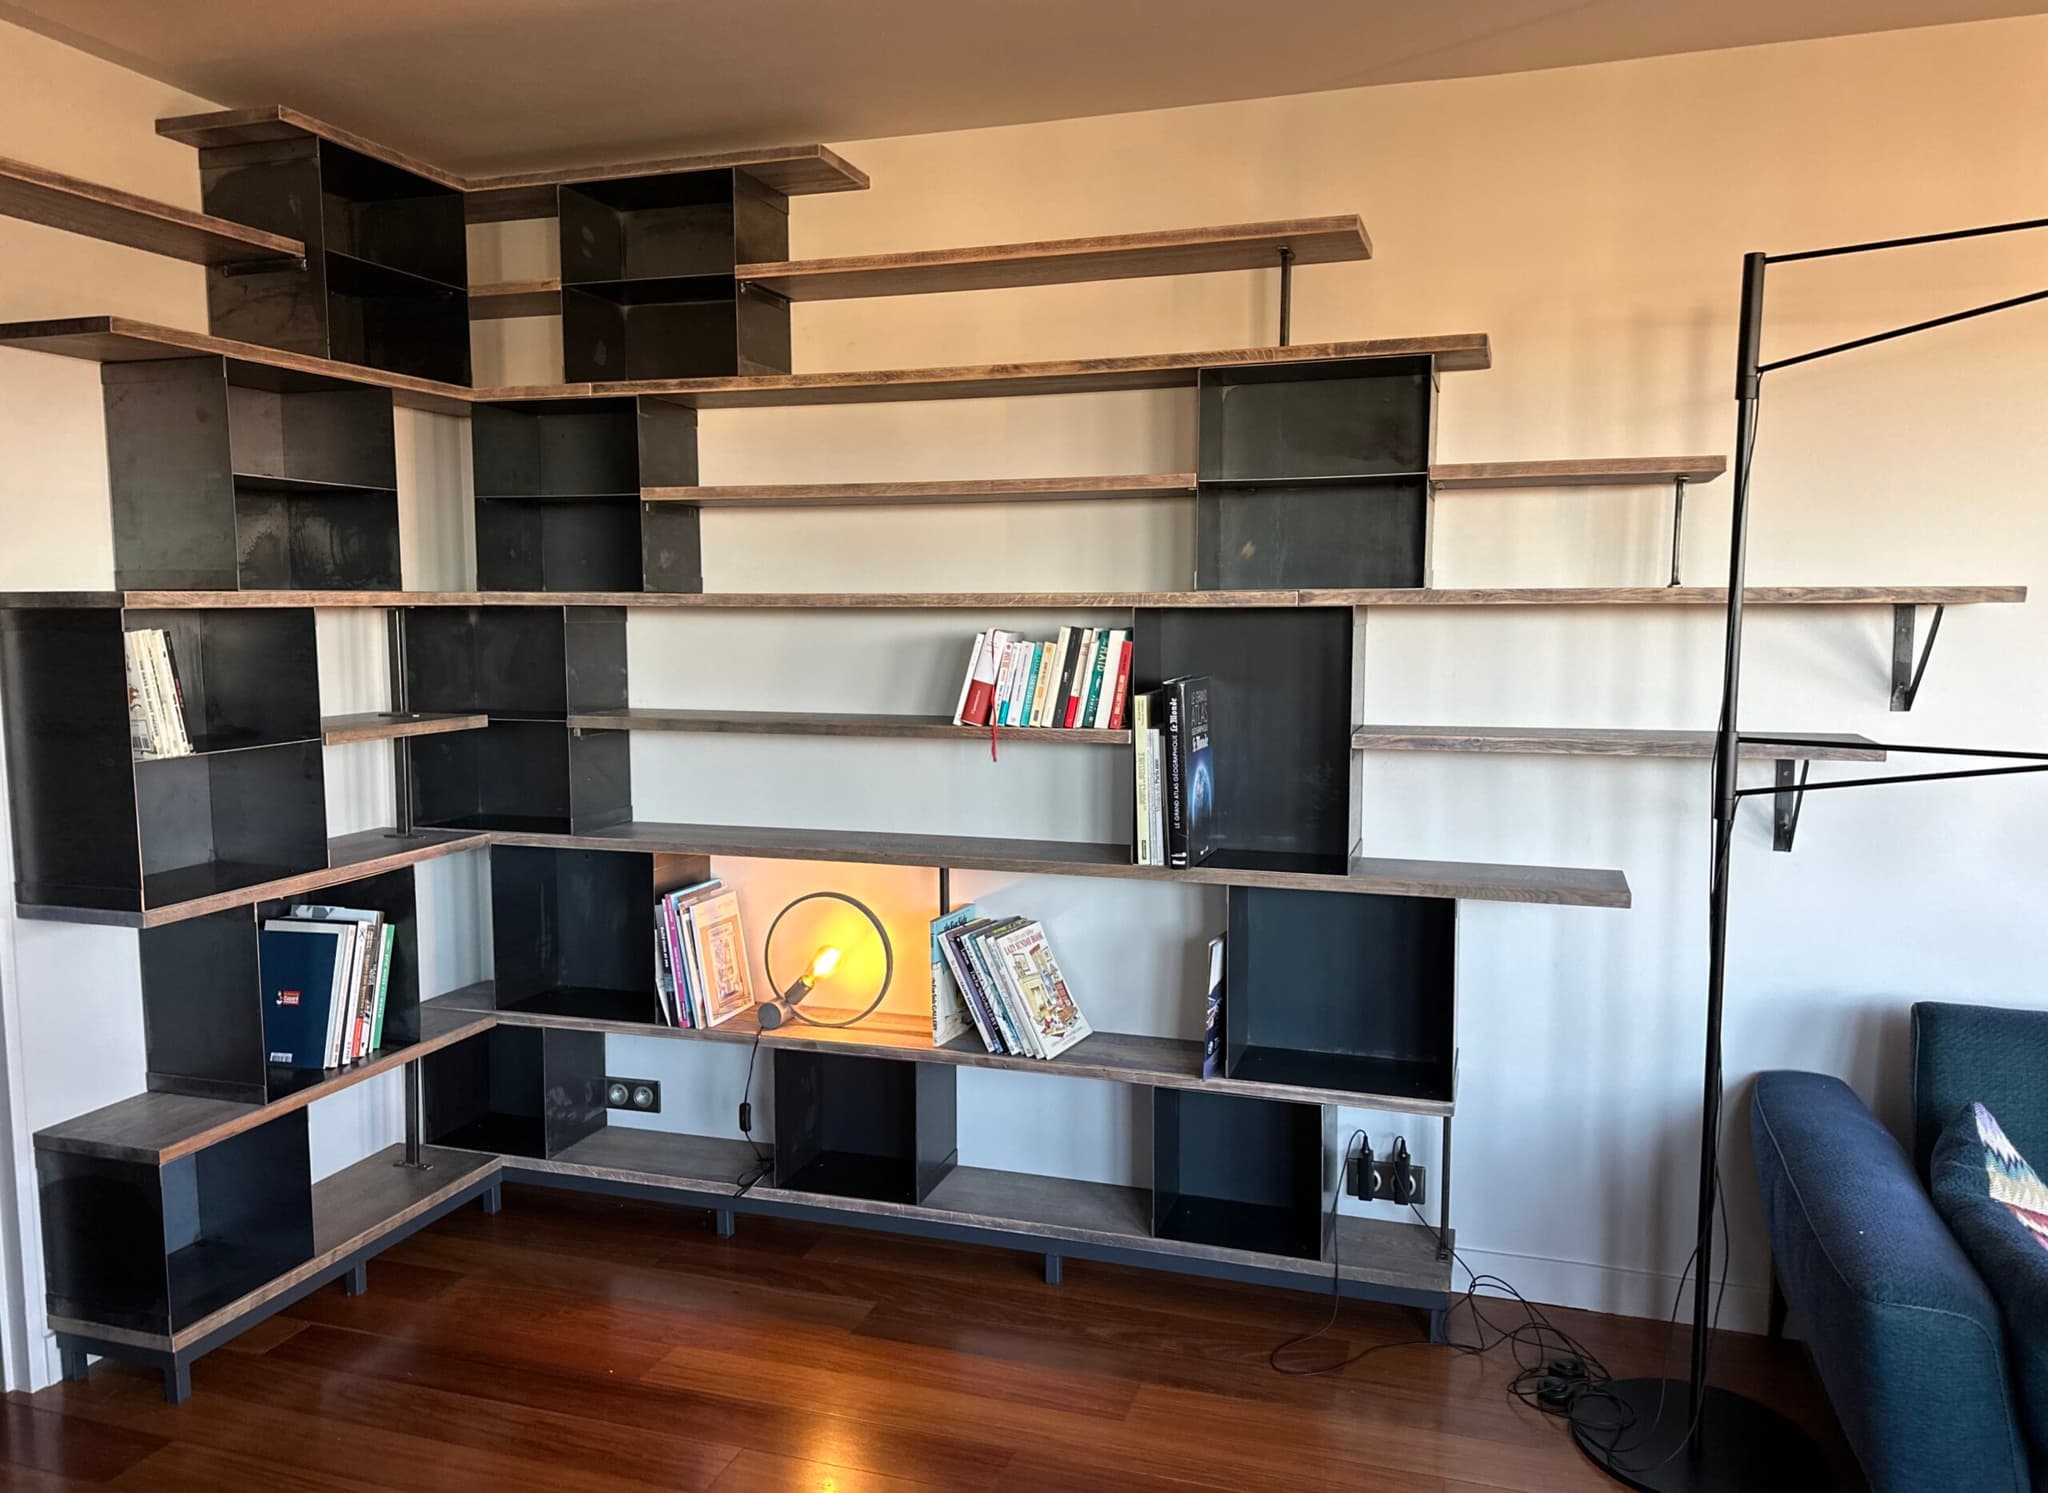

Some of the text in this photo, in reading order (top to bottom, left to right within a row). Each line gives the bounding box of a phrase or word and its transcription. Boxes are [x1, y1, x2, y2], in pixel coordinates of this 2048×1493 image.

[1191, 703, 1208, 726] ATLAS
[1170, 724, 1178, 732] Le
[1197, 734, 1208, 751] Monde
[981, 997, 998, 1026] GALLERY
